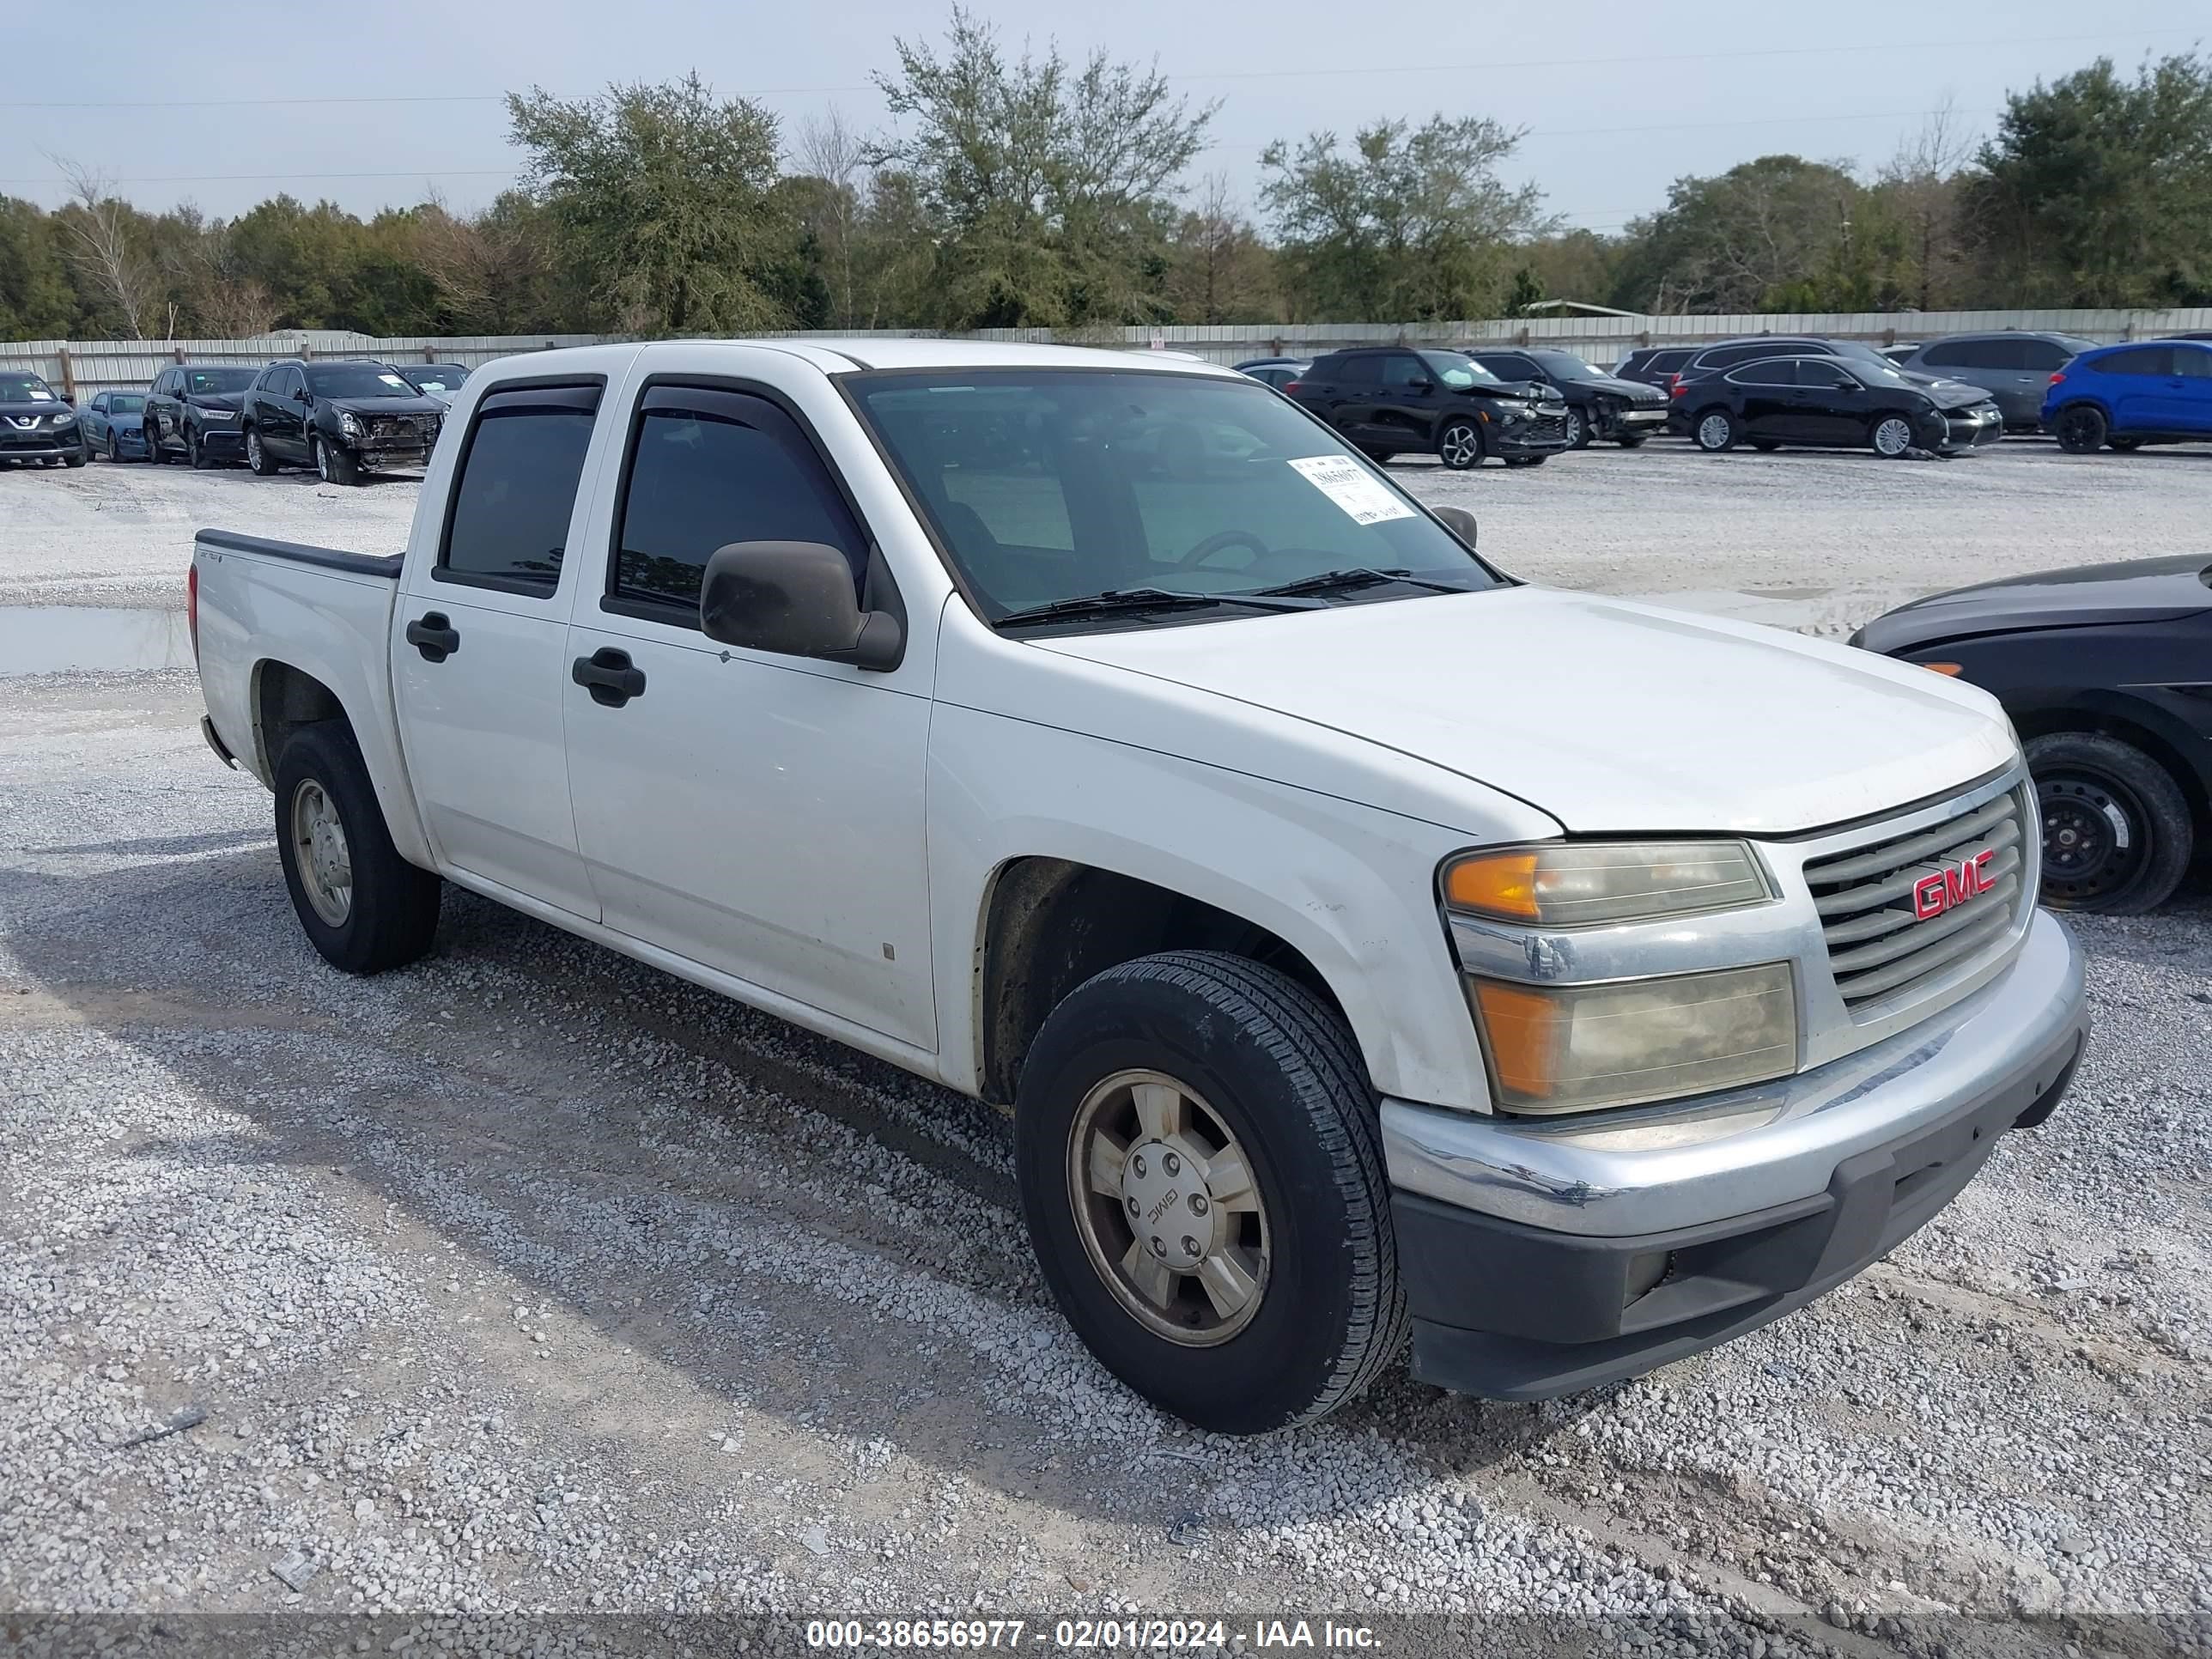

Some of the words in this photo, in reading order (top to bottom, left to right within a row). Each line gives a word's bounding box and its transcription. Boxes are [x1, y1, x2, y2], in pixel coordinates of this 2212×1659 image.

[1312, 469, 1366, 485] 38656977
[1914, 848, 1996, 921] GMC
[1147, 1188, 1178, 1224] GMC
